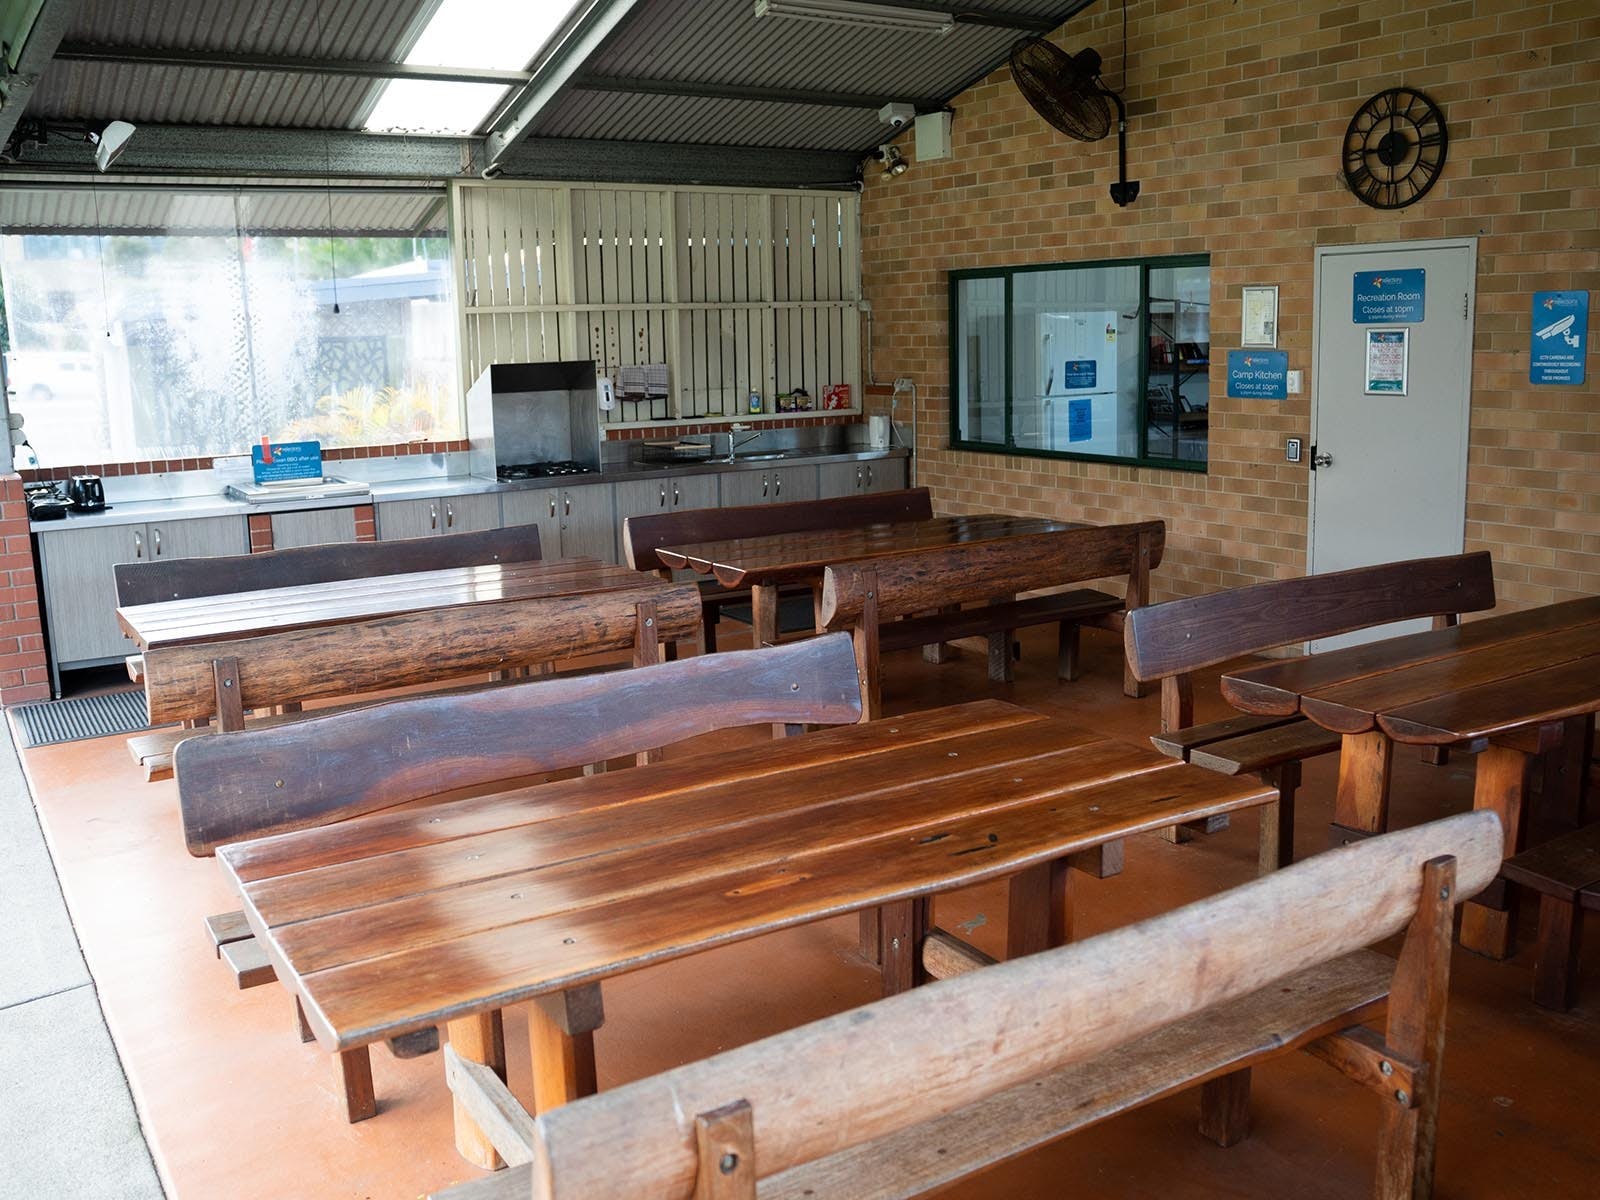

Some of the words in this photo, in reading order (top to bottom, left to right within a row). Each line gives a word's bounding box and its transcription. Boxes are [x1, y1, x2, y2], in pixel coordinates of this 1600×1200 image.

[1357, 293, 1396, 301] Recreation
[1397, 291, 1421, 300] Room
[1362, 305, 1385, 313] Closes
[1394, 305, 1414, 313] 10pm
[1232, 370, 1254, 380] Camp
[1254, 370, 1283, 380] Kitchen
[1235, 382, 1255, 390] Closes
[1262, 383, 1279, 391] 10pm
